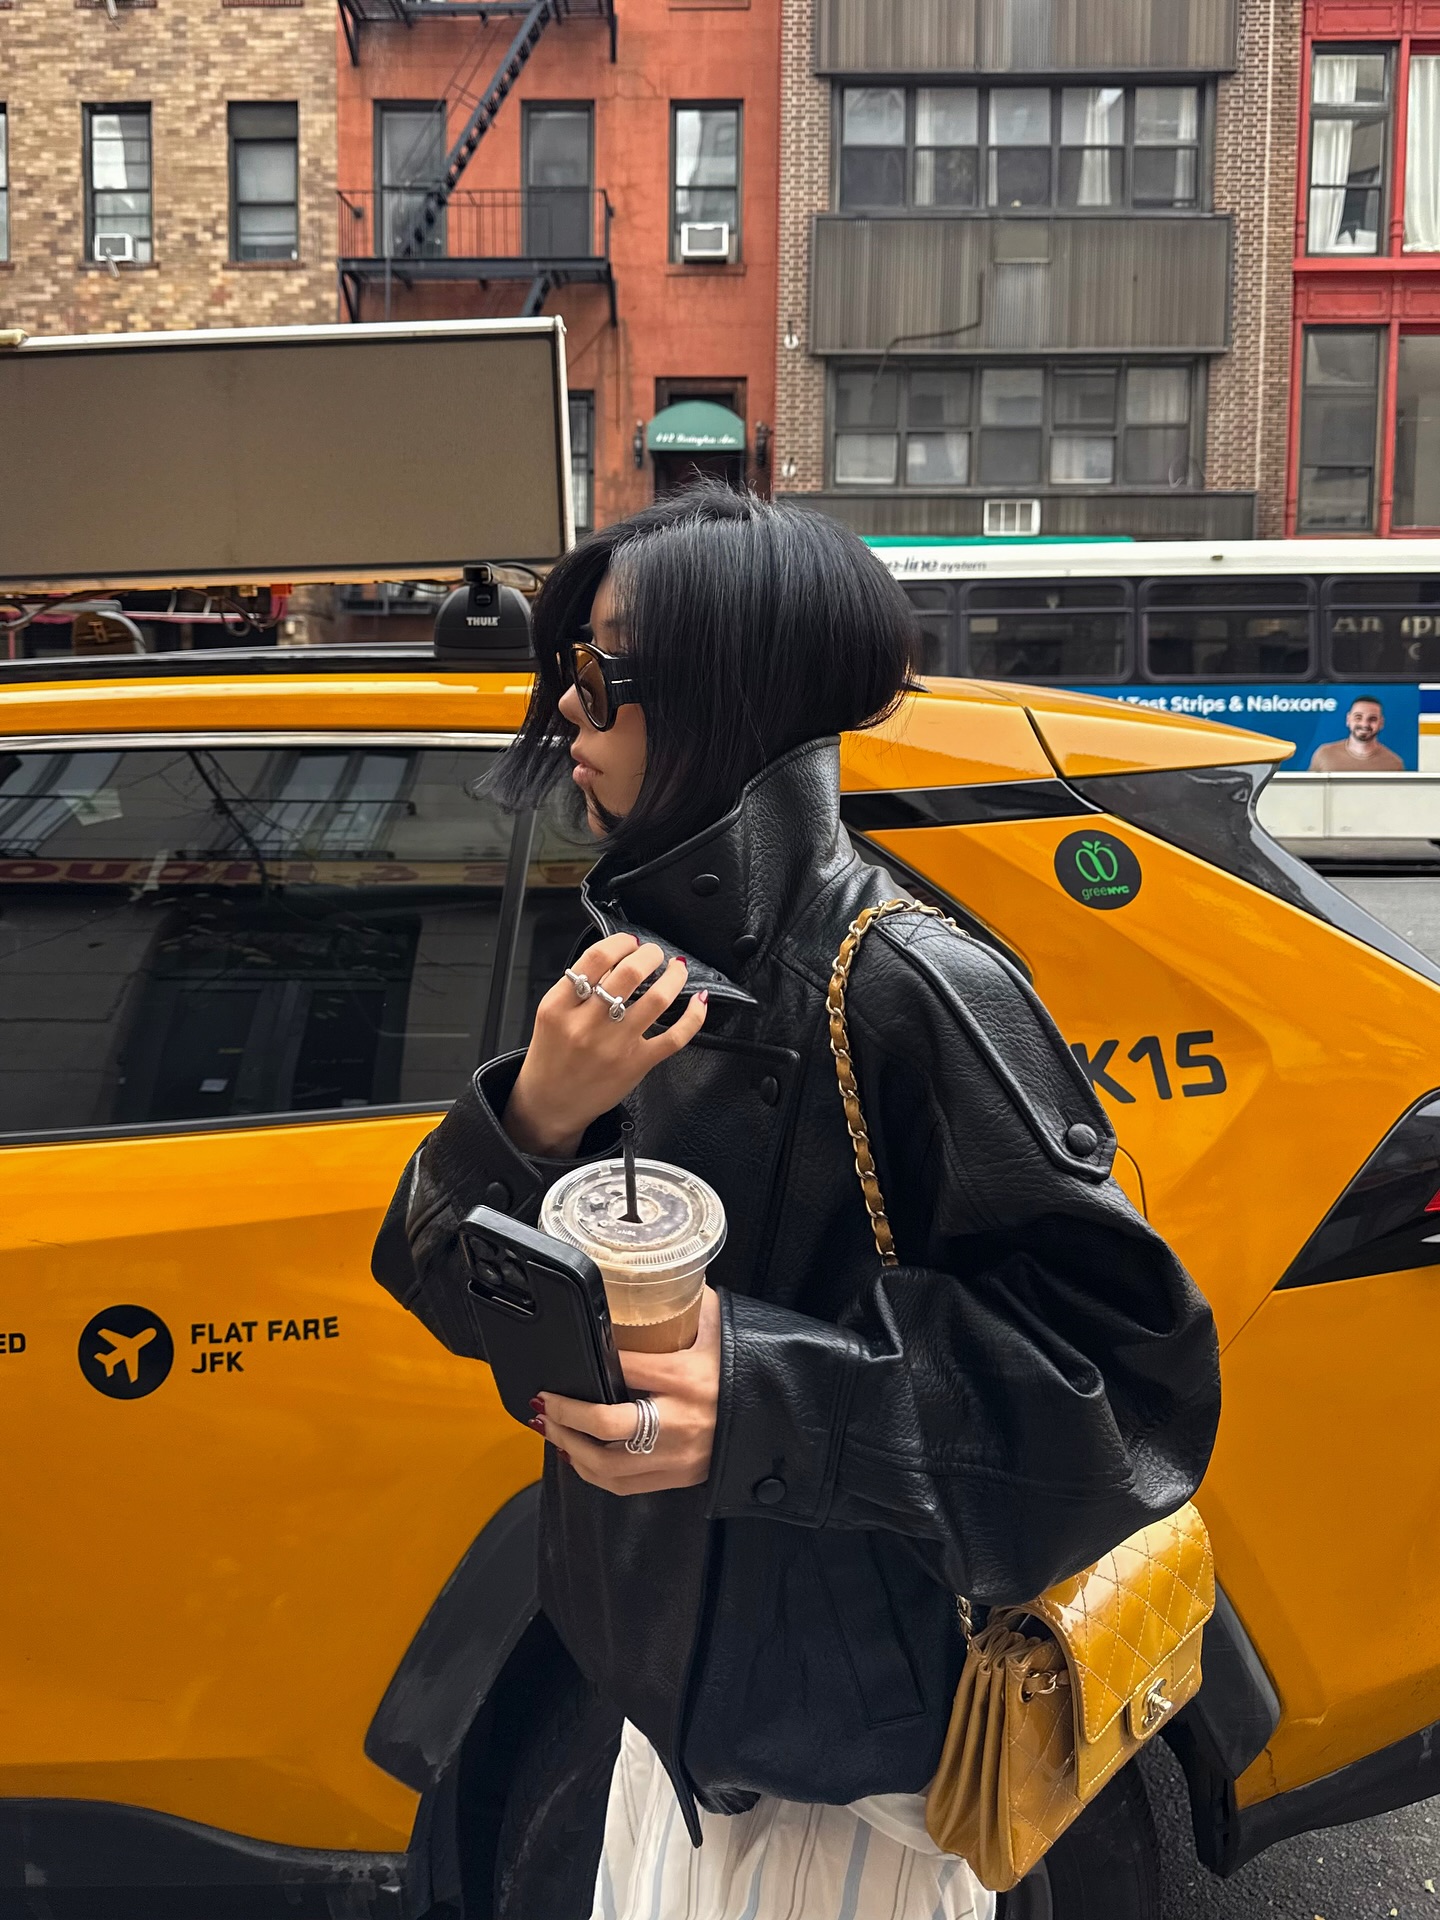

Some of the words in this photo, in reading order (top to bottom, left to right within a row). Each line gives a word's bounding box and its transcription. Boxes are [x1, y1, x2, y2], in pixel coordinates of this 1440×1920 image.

[466, 616, 499, 627] THULE
[1170, 694, 1227, 716] Strips
[1228, 695, 1244, 713] &
[1246, 694, 1338, 713] Naloxone
[1081, 885, 1130, 901] greeNYC
[190, 1320, 259, 1345] FLAT
[267, 1315, 340, 1342] FARE
[191, 1350, 245, 1374] JFK
